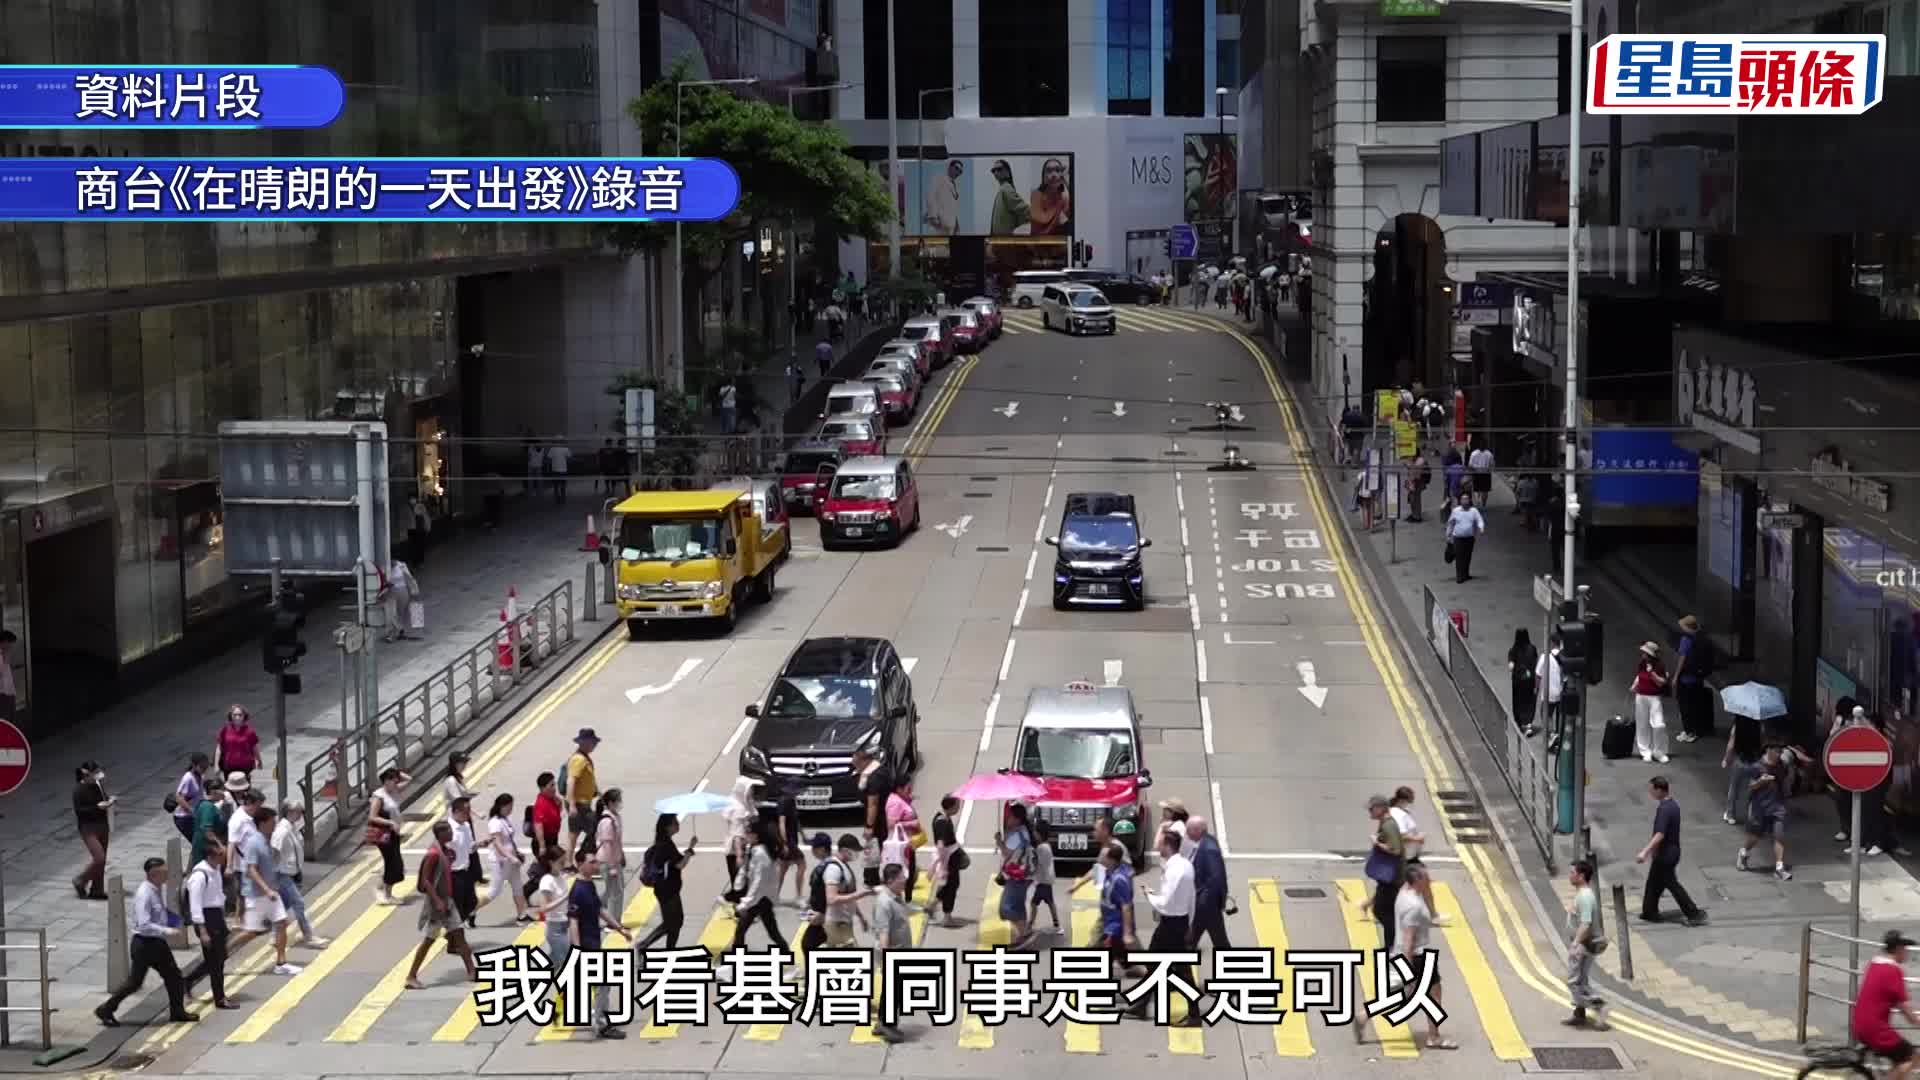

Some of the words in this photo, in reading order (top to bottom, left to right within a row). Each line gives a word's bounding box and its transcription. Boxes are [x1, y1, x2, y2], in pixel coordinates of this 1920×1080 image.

[1132, 156, 1172, 184] M&S
[1233, 529, 1322, 549] 巴士
[1232, 559, 1338, 573] STOP
[1244, 584, 1336, 599] BUS
[1068, 683, 1094, 691] TAXI
